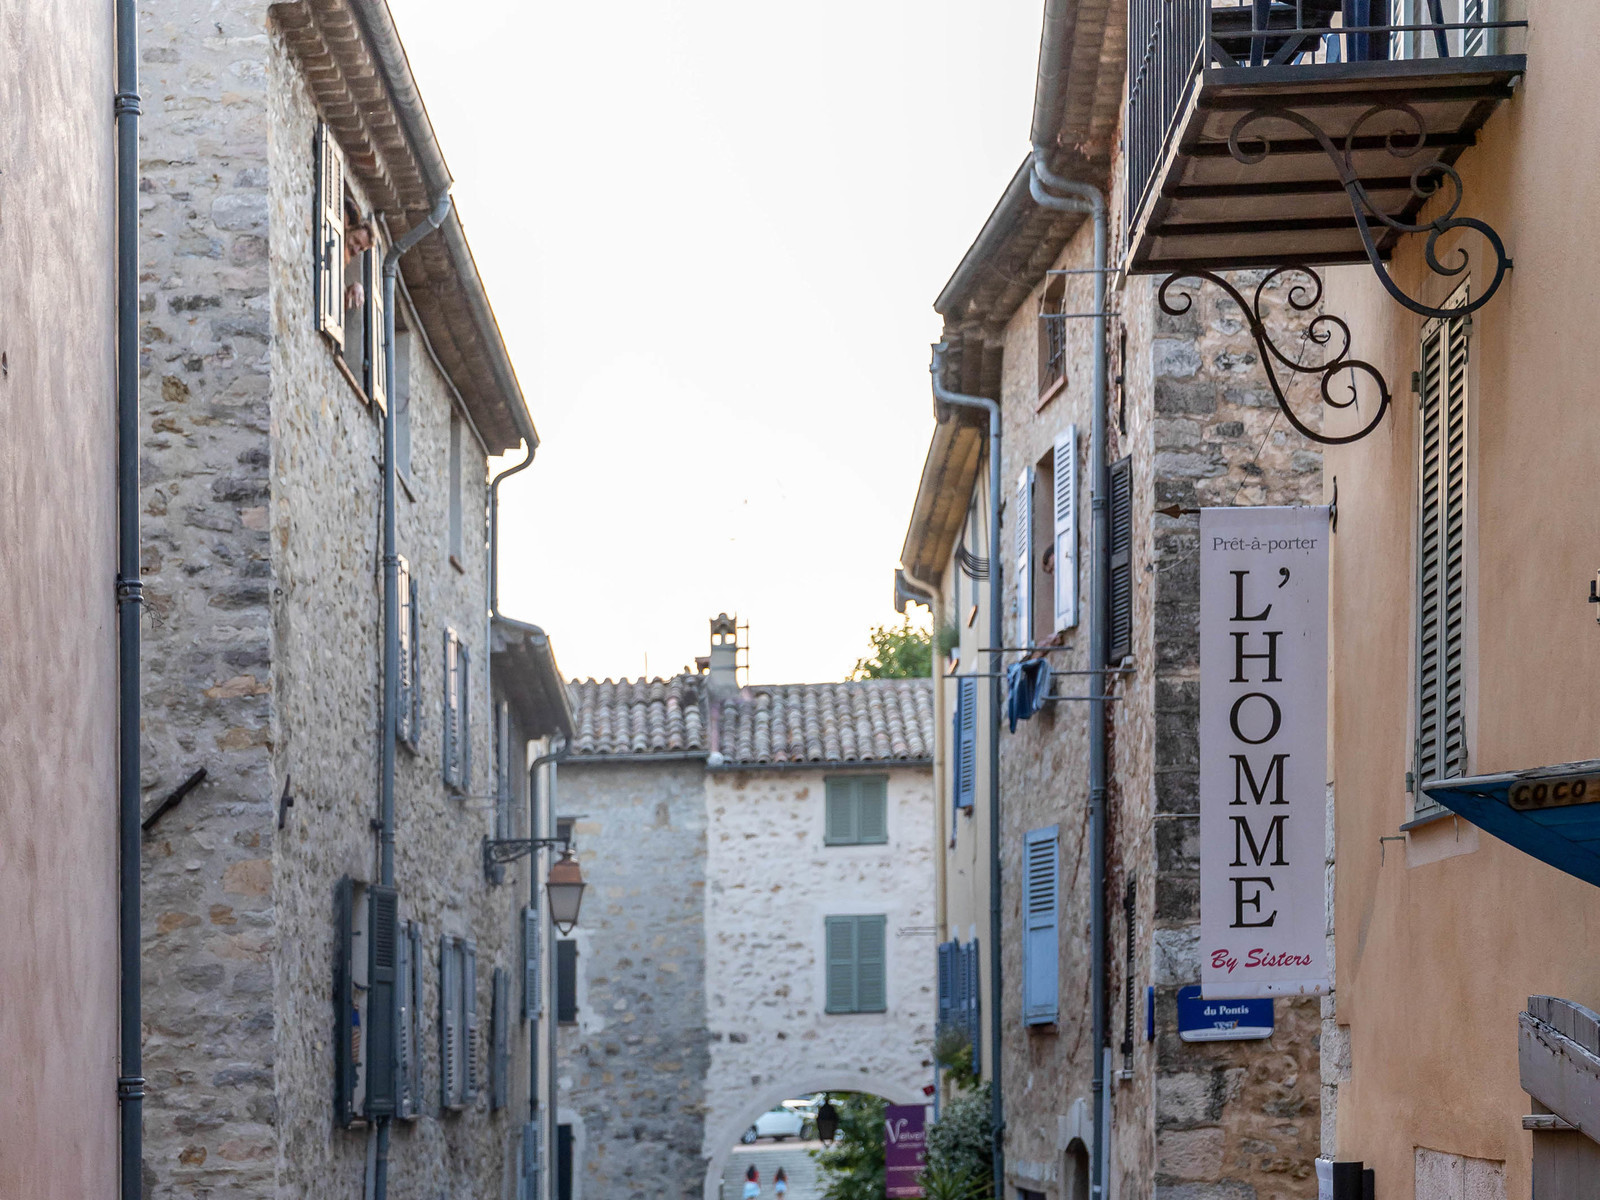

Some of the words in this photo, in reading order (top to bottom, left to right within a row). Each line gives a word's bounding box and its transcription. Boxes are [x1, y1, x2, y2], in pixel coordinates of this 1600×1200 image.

[1213, 536, 1318, 553] Prêt-à-porter
[1211, 949, 1239, 974] By
[1244, 948, 1313, 968] Sisters
[1203, 1006, 1217, 1016] du
[1219, 1004, 1249, 1016] Pontis
